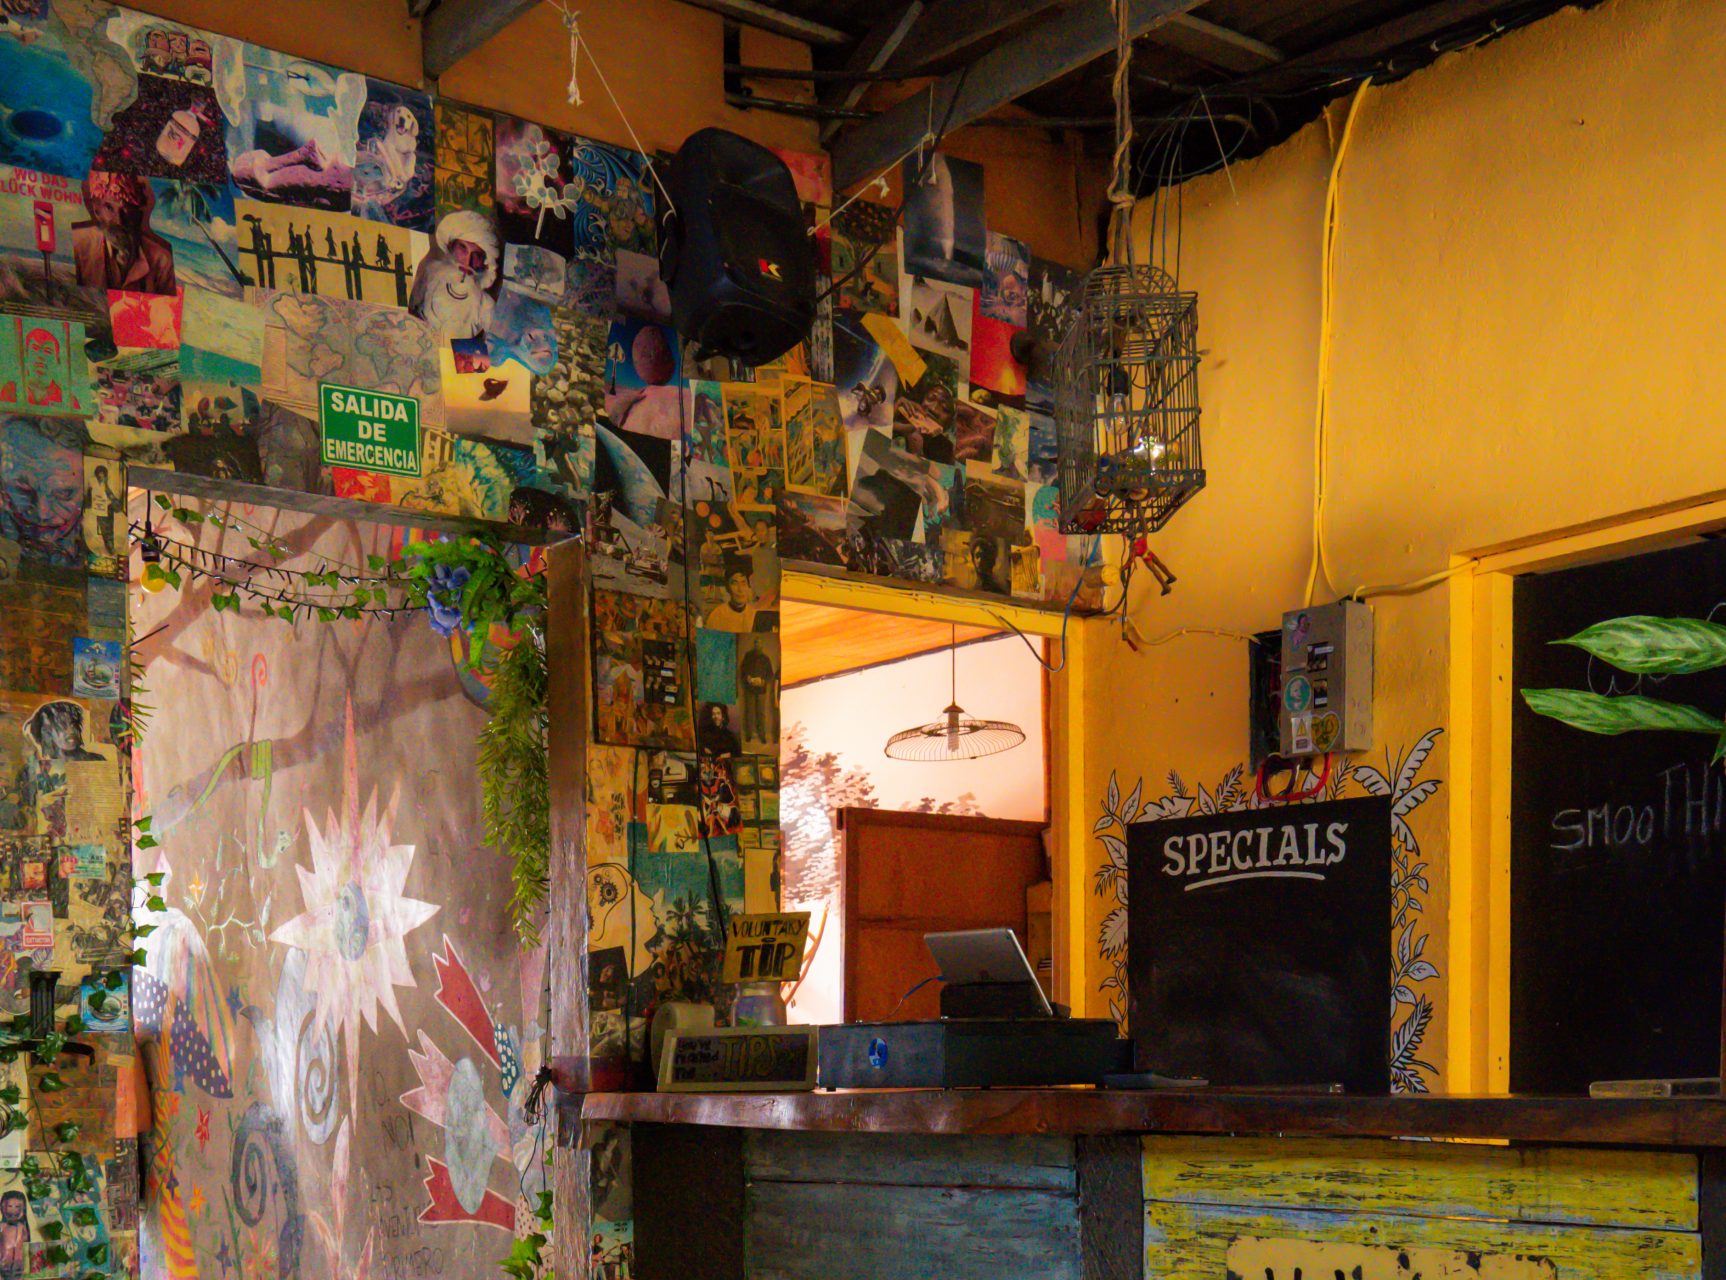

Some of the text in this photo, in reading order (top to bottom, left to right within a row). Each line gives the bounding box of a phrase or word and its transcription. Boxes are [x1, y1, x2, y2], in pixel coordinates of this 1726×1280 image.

[14, 166, 68, 188] WO DAS
[331, 391, 409, 423] SALIDA
[358, 420, 387, 442] DE
[1161, 822, 1350, 877] SPECIALS
